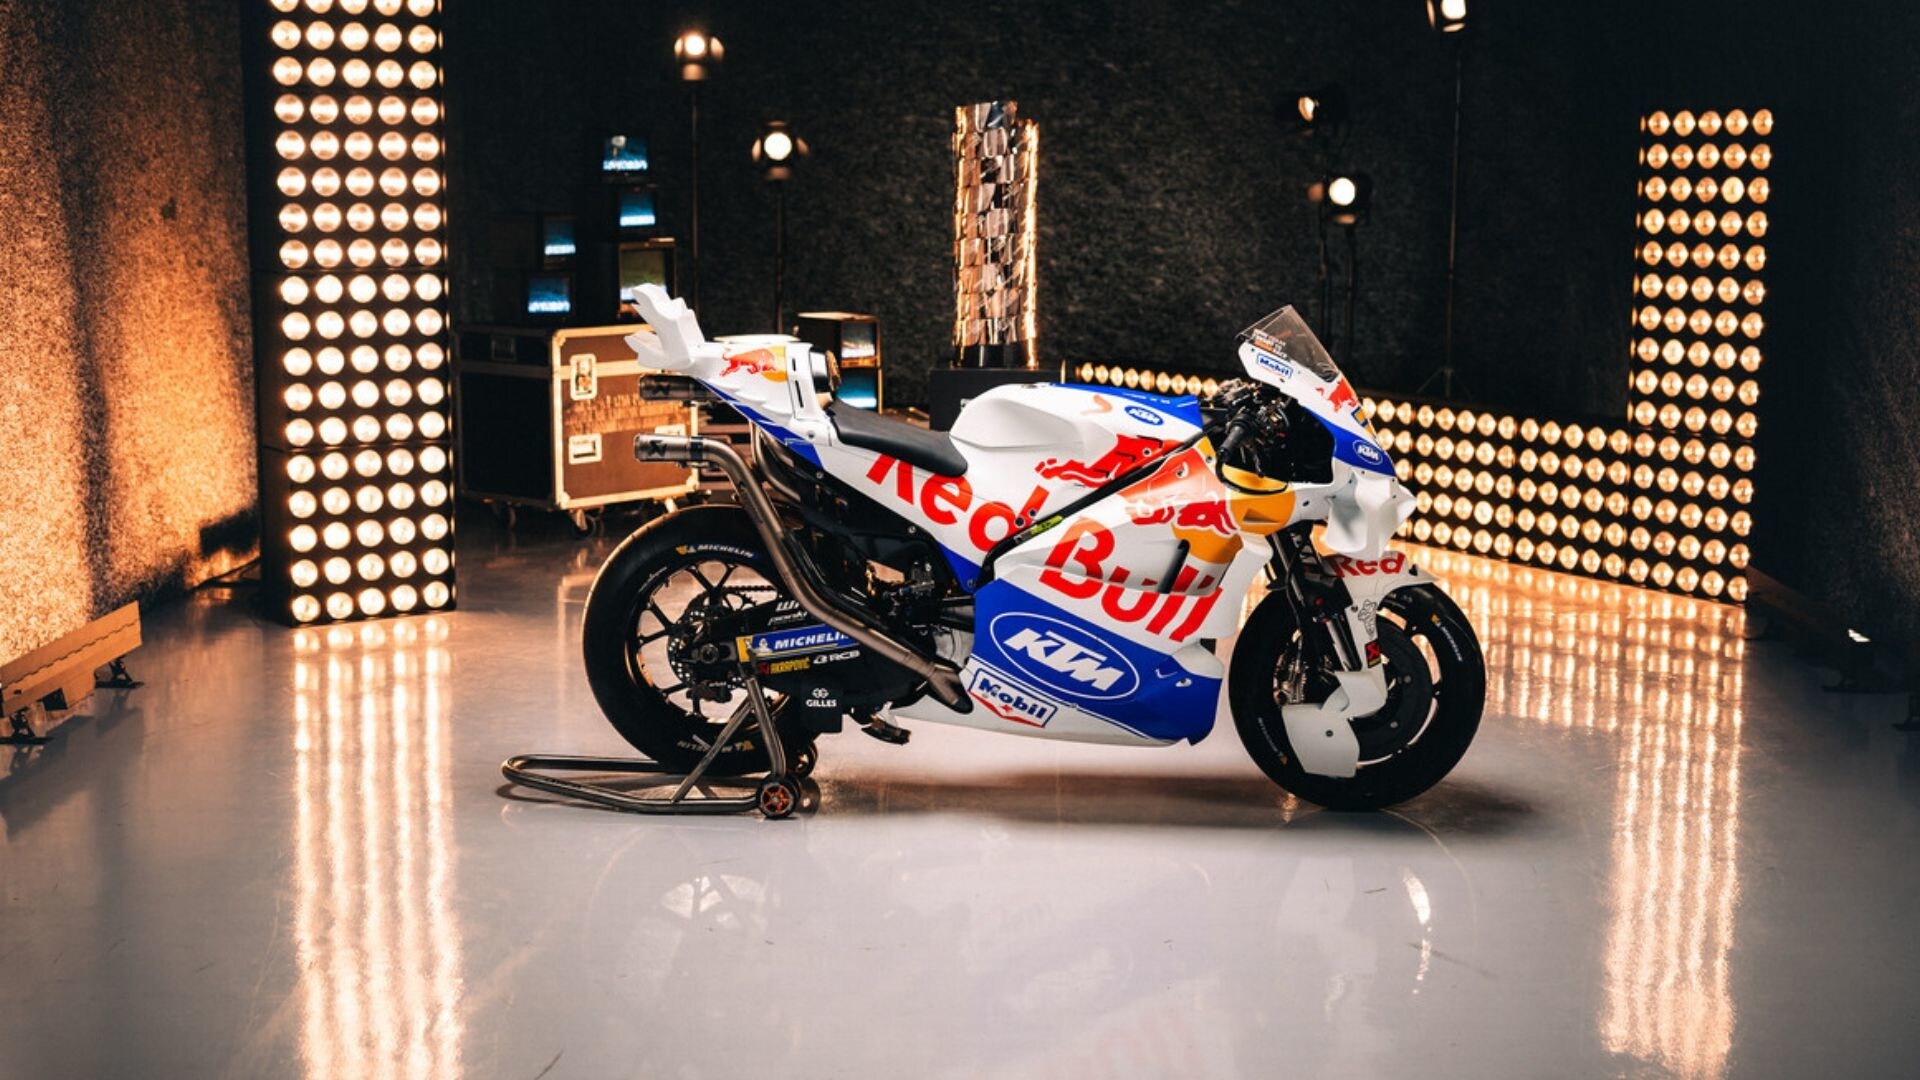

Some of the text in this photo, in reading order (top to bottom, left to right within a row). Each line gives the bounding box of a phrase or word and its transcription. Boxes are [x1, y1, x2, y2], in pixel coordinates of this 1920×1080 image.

[1128, 408, 1160, 425] KTM
[1038, 516, 1223, 642] Bull
[1328, 550, 1406, 579] Red
[1003, 628, 1127, 692] KTM
[805, 699, 837, 707] GILLES
[979, 678, 1048, 719] Mobil
